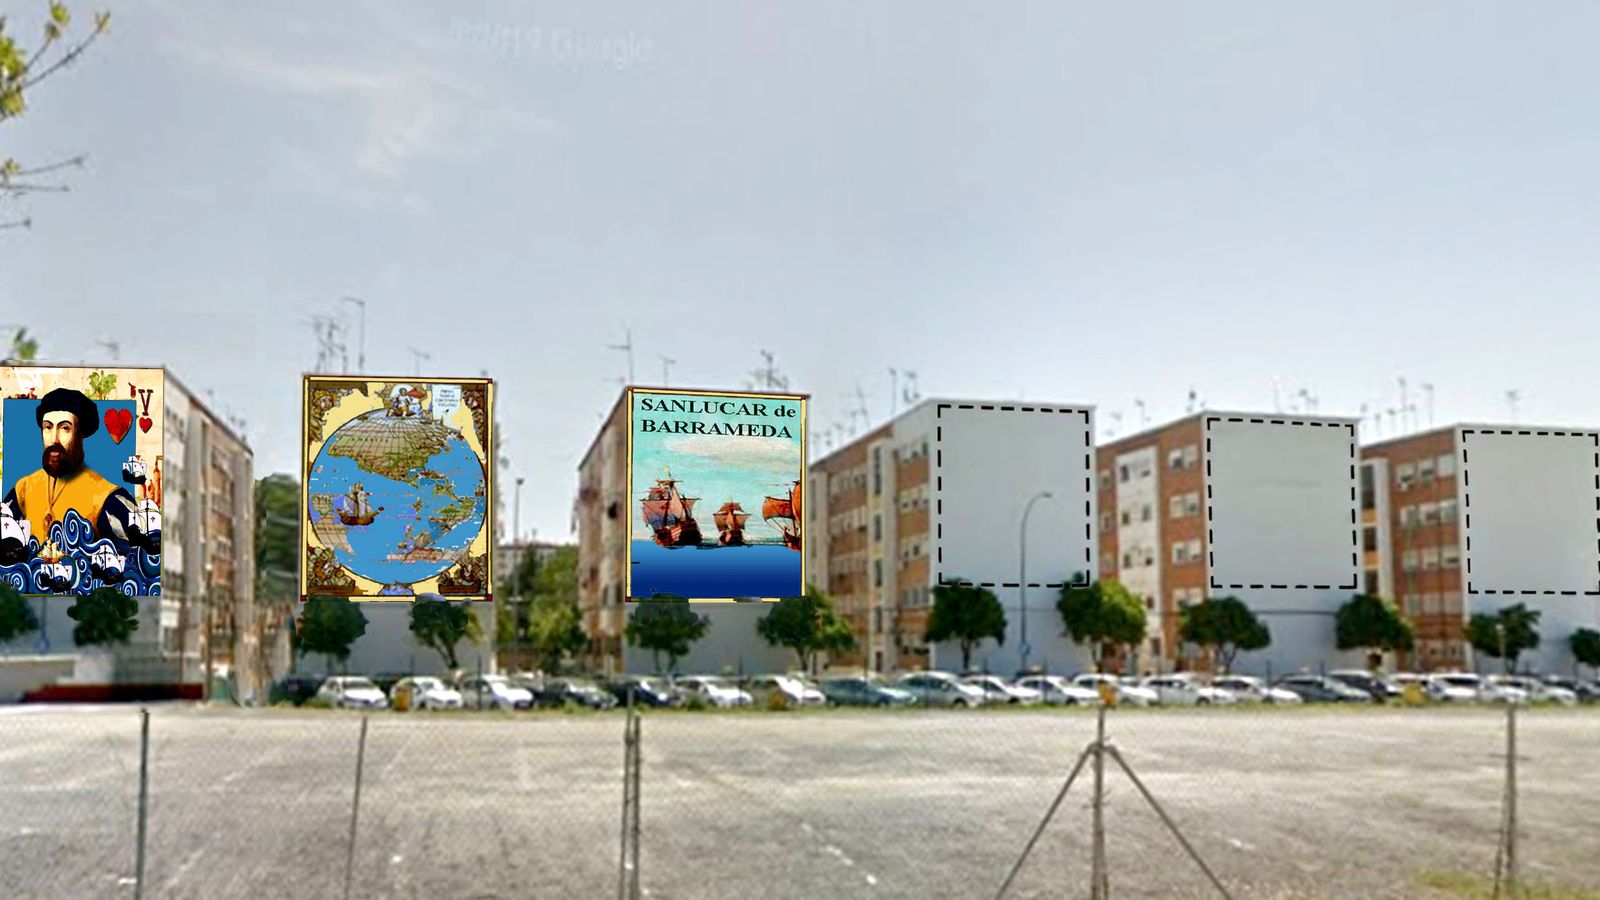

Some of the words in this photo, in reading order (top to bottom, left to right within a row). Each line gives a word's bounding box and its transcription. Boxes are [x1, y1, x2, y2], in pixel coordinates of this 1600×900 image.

[641, 398, 768, 416] SANLUCAR
[774, 405, 796, 418] de
[641, 419, 792, 438] BARRAMEDA
